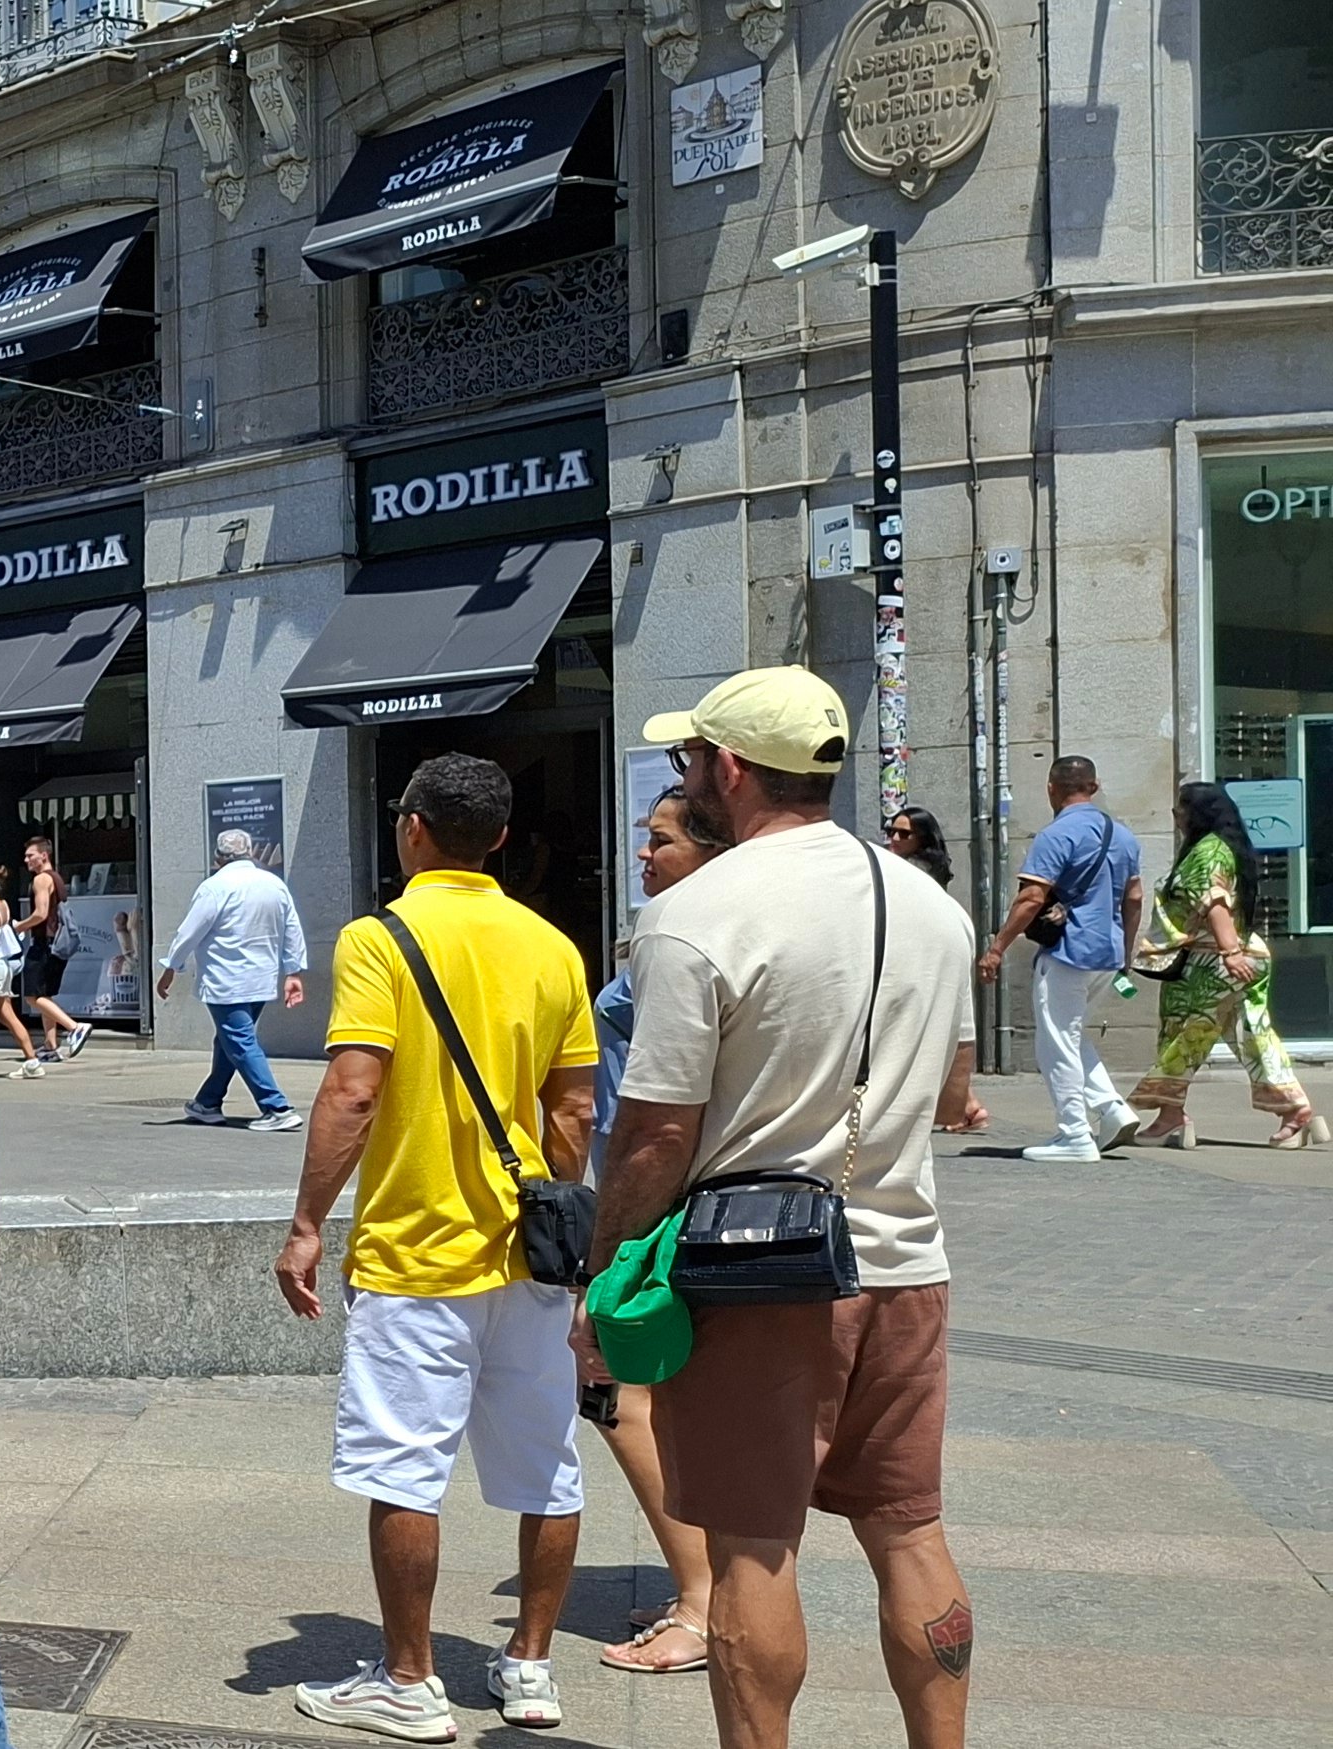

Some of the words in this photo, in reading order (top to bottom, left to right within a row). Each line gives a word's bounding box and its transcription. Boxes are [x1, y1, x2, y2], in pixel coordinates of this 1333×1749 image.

[888, 67, 935, 98] DE
[381, 133, 528, 193] RODILLA
[674, 137, 735, 165] PUERTA
[736, 131, 760, 148] DEL
[402, 216, 482, 251] RODILLA
[371, 449, 591, 524] RODILLA
[362, 693, 442, 715] RODILLA
